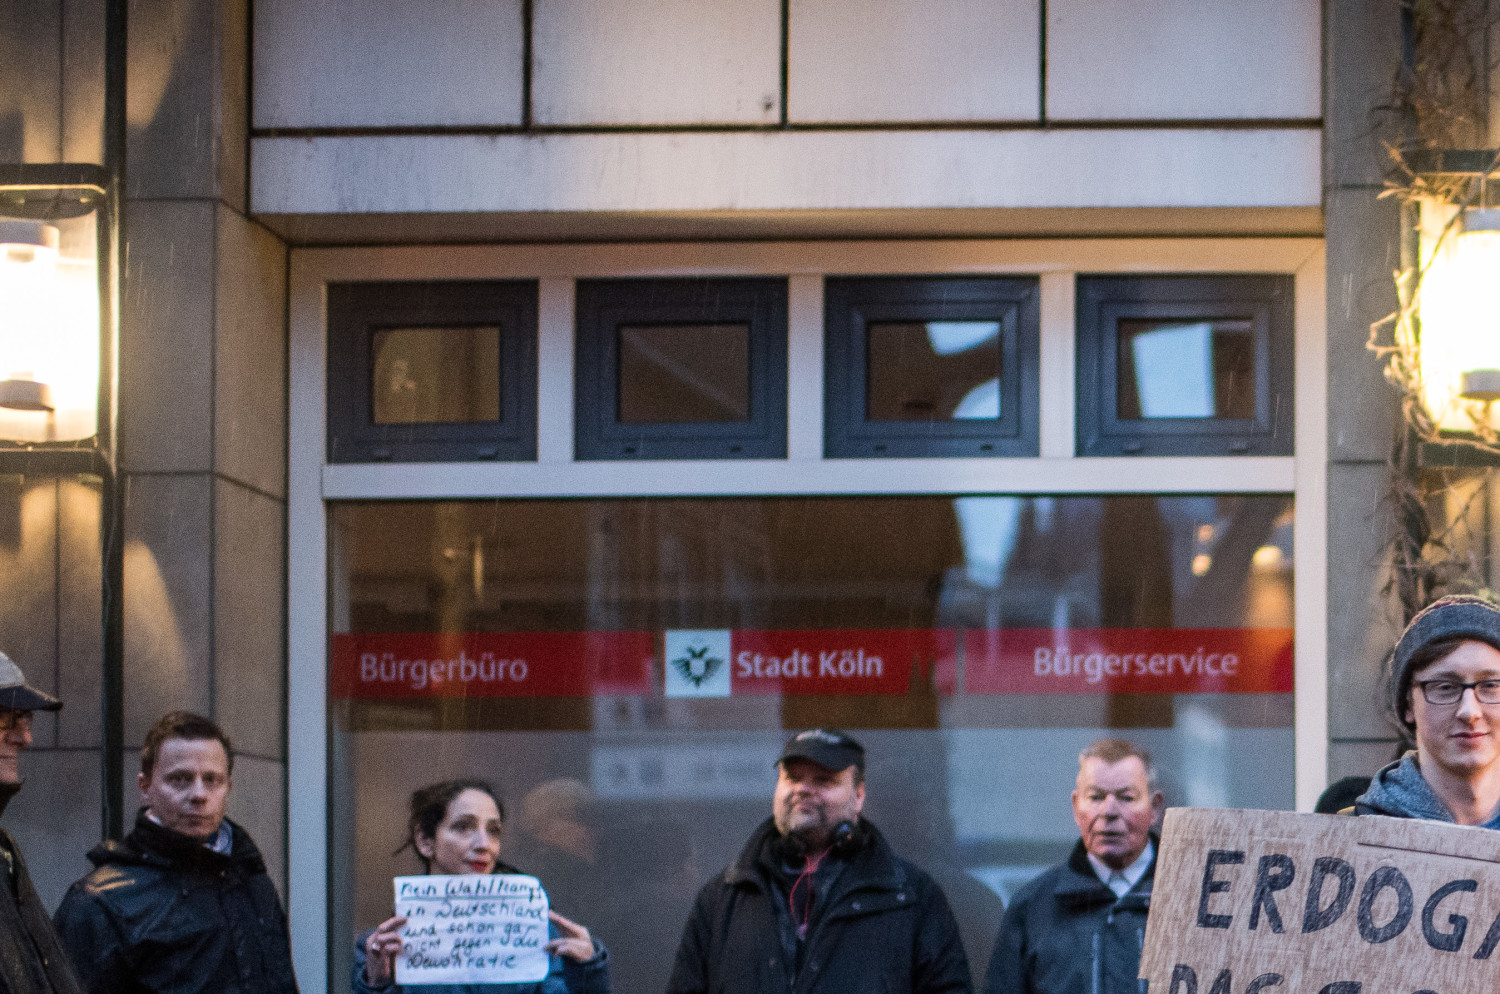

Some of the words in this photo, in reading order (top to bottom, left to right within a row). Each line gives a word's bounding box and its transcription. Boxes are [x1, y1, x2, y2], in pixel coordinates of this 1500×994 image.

[360, 653, 528, 689] Bürgerbüro
[736, 651, 812, 678] Stadt
[819, 650, 882, 677] Köln
[1034, 647, 1238, 683] Bürgerservice
